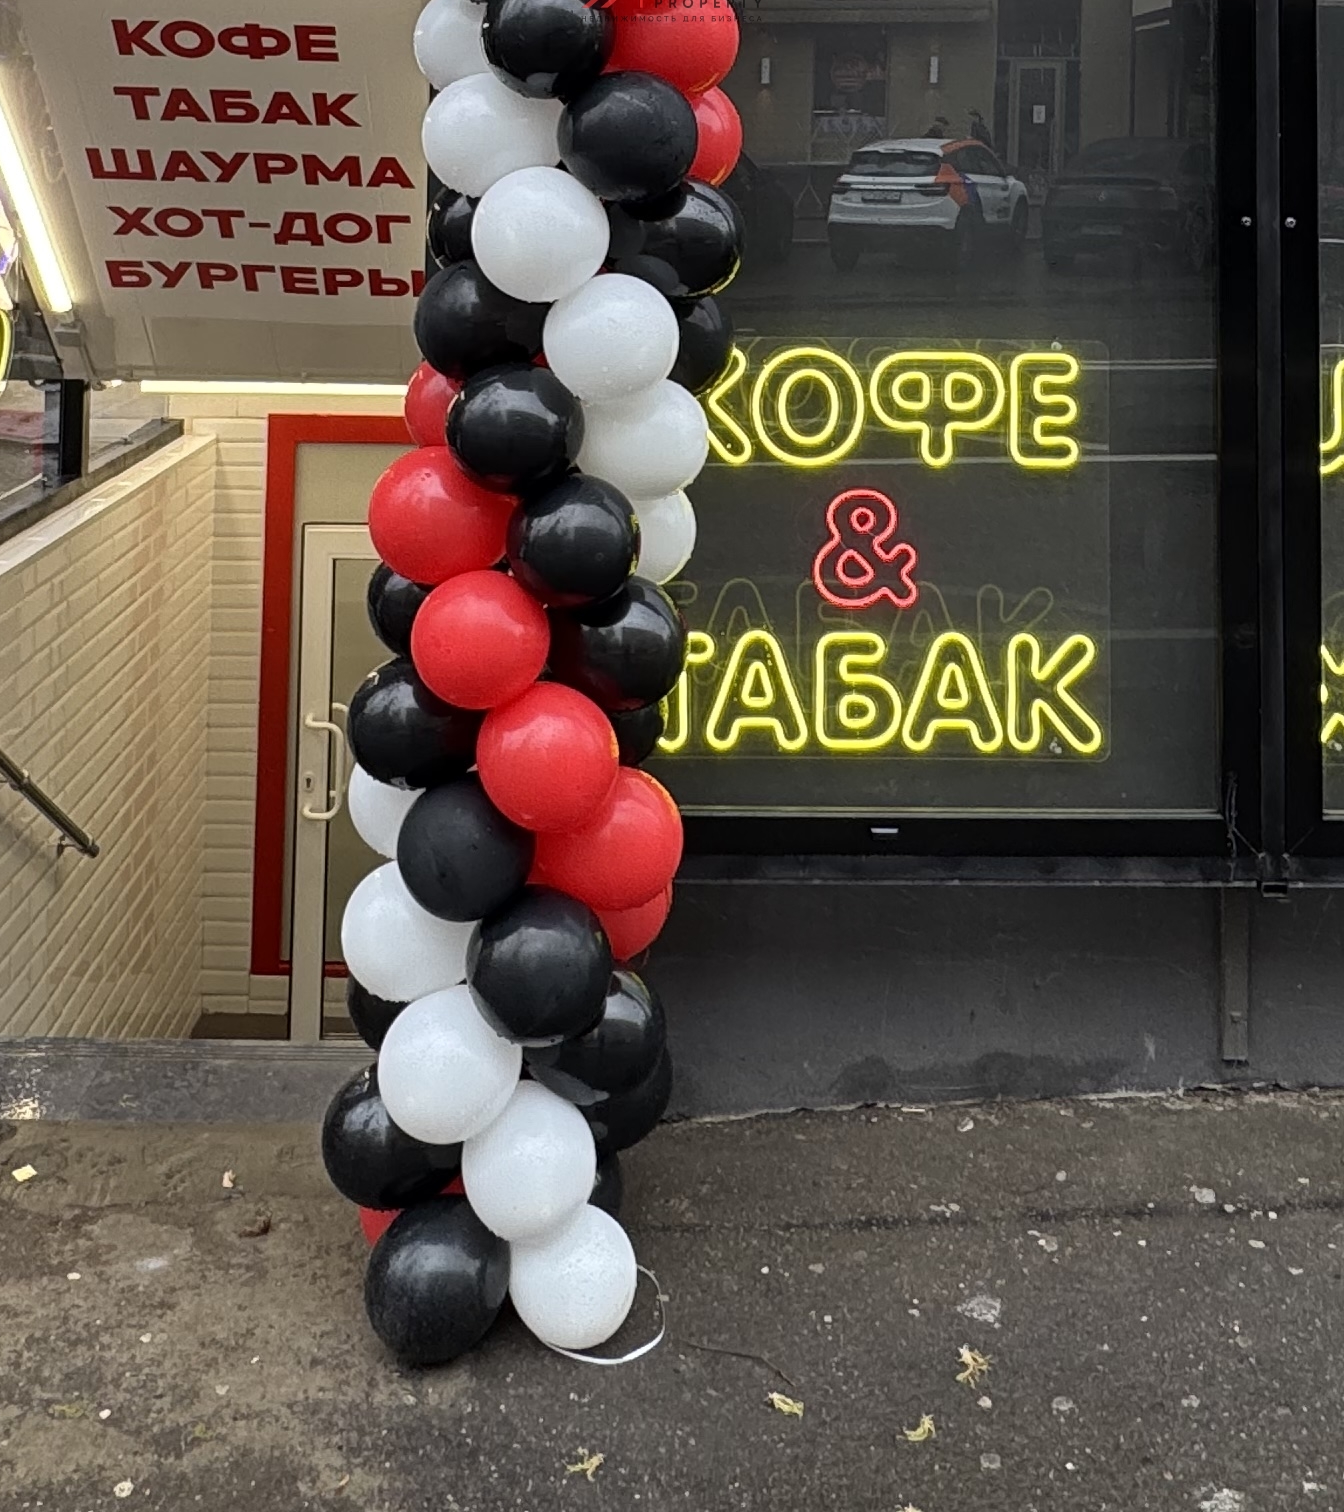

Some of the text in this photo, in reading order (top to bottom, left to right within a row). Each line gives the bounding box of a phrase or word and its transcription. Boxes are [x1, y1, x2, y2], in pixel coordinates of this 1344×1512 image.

[111, 18, 339, 63] КОФЕ
[113, 85, 361, 128] ТАБАК
[85, 148, 415, 190] ШАУРМА
[107, 206, 411, 245] ХОТ-ДОГ
[813, 488, 918, 607] &
